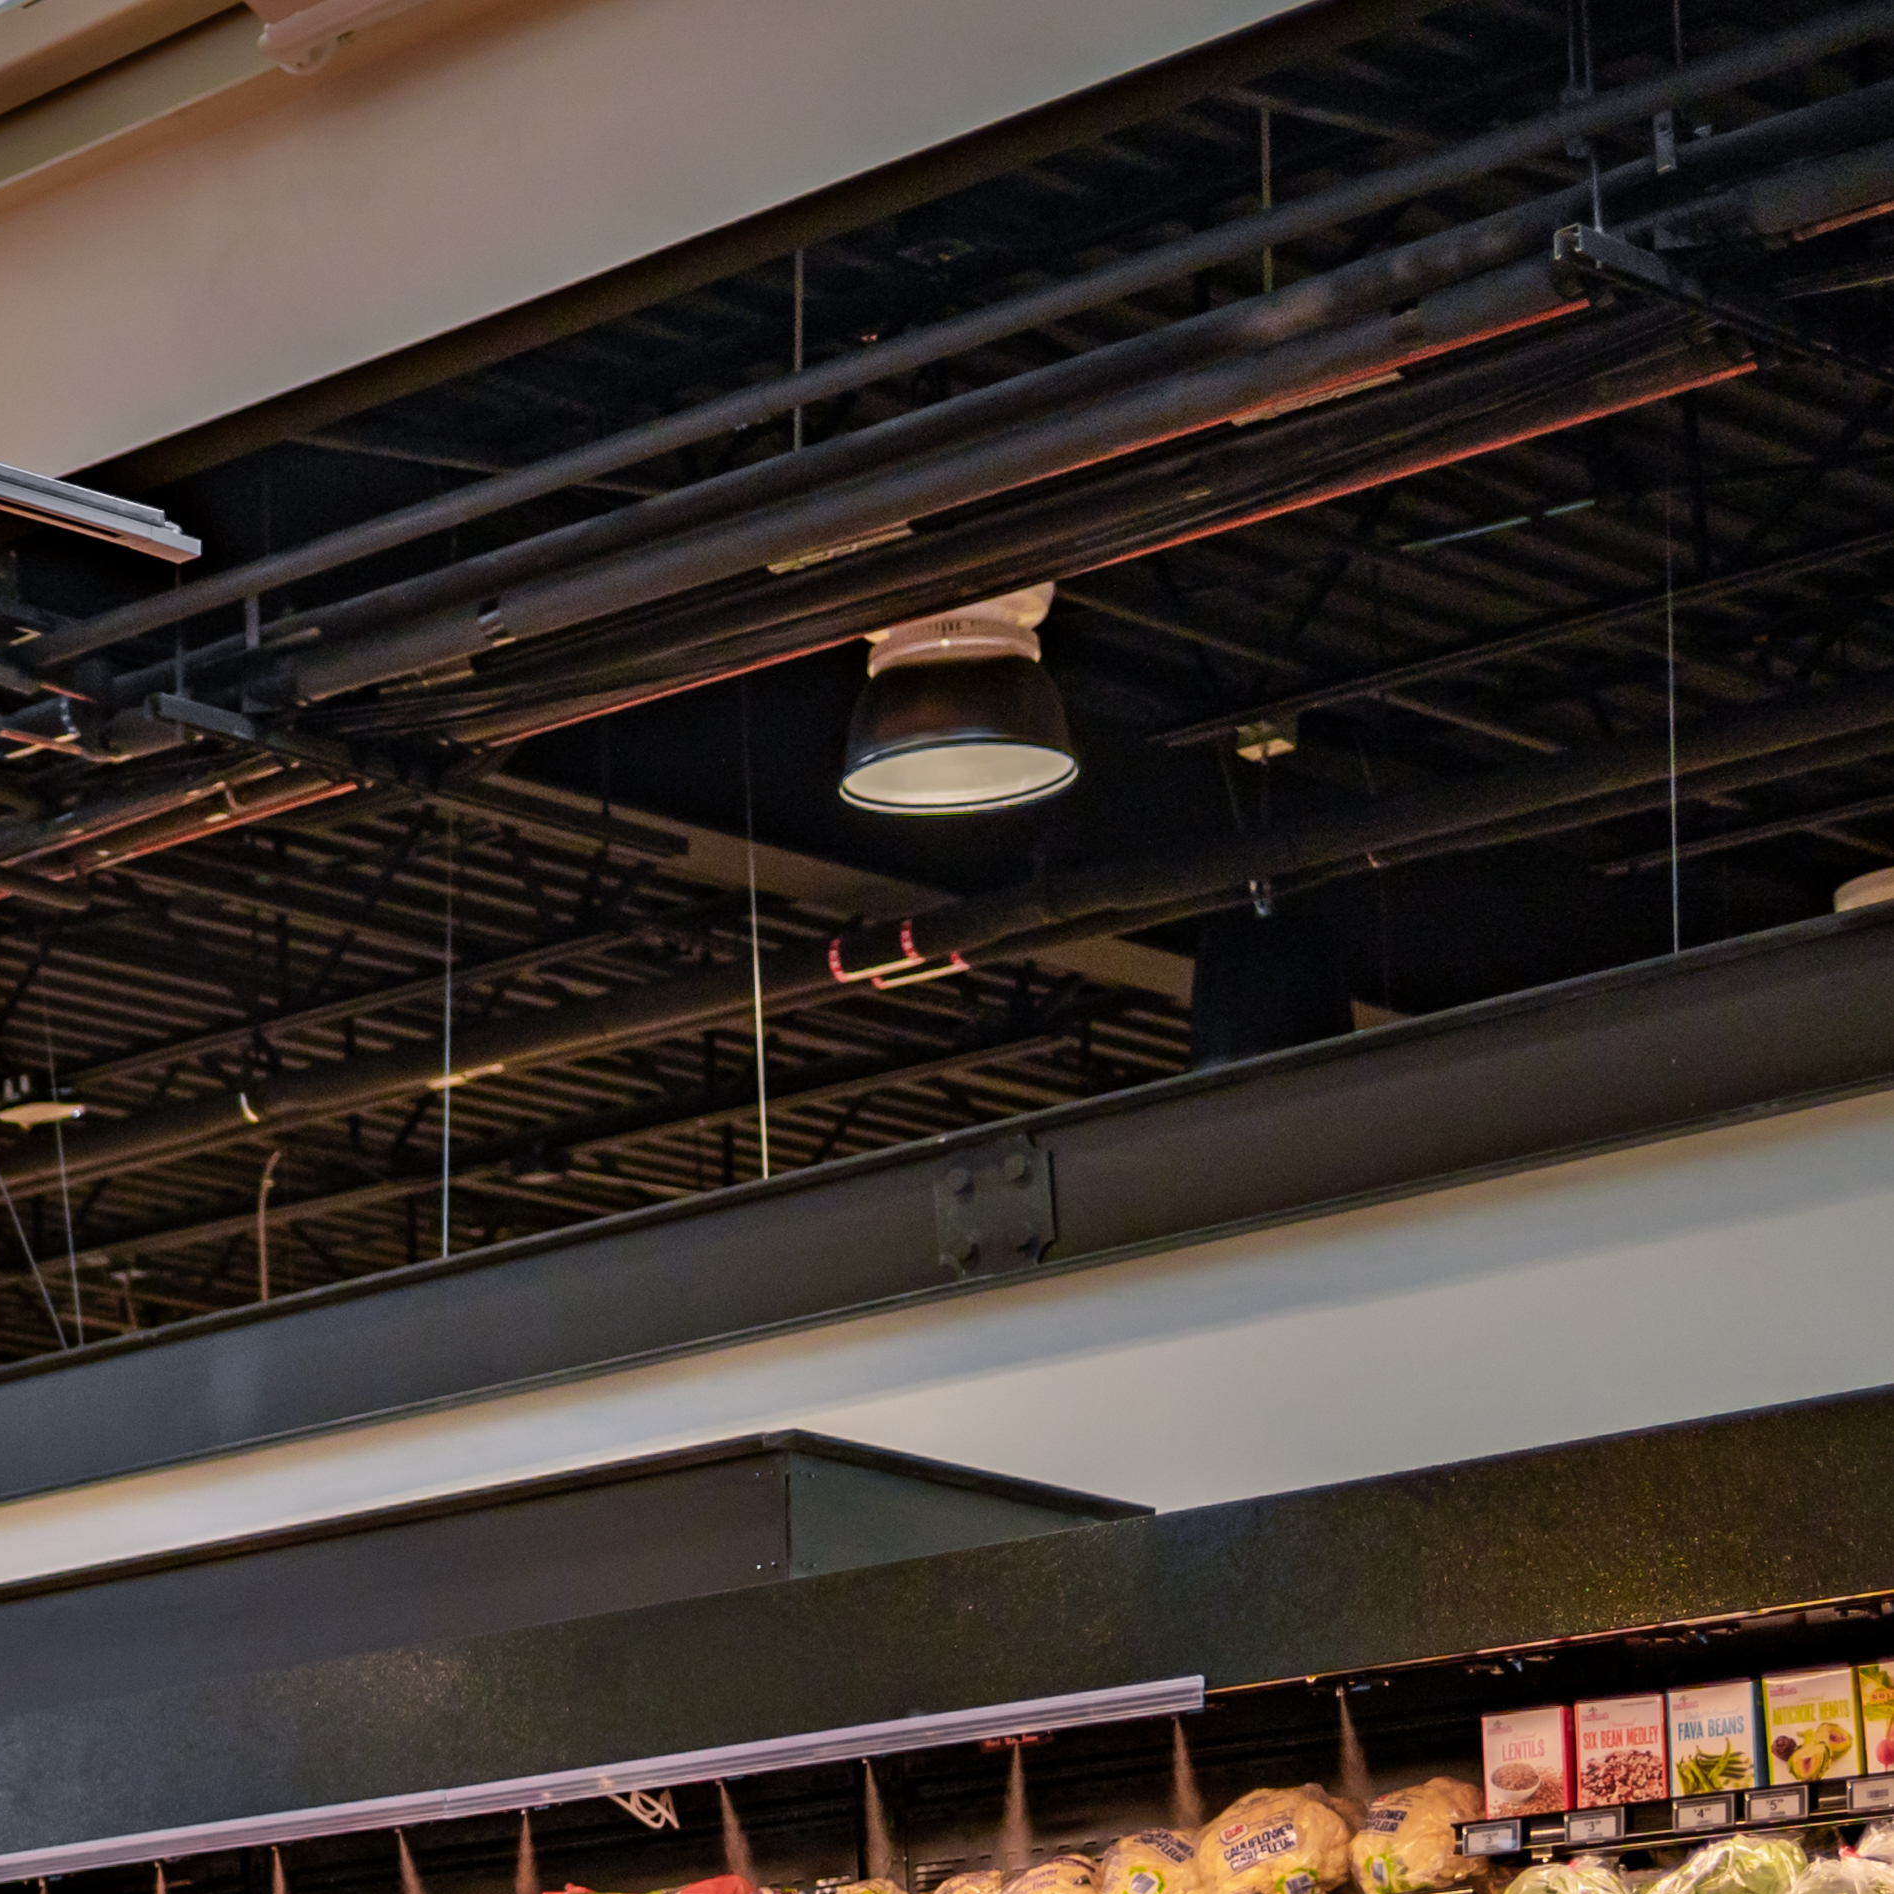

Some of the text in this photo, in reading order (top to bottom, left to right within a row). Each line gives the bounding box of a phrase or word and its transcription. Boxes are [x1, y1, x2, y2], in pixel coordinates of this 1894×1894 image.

[1872, 1691, 1894, 1699] GOL
[1583, 1725, 1659, 1750] SIX BEAN MEDLEY
[1678, 1715, 1744, 1741] FAVA BEANS
[1502, 1739, 1545, 1762] LENTILS
